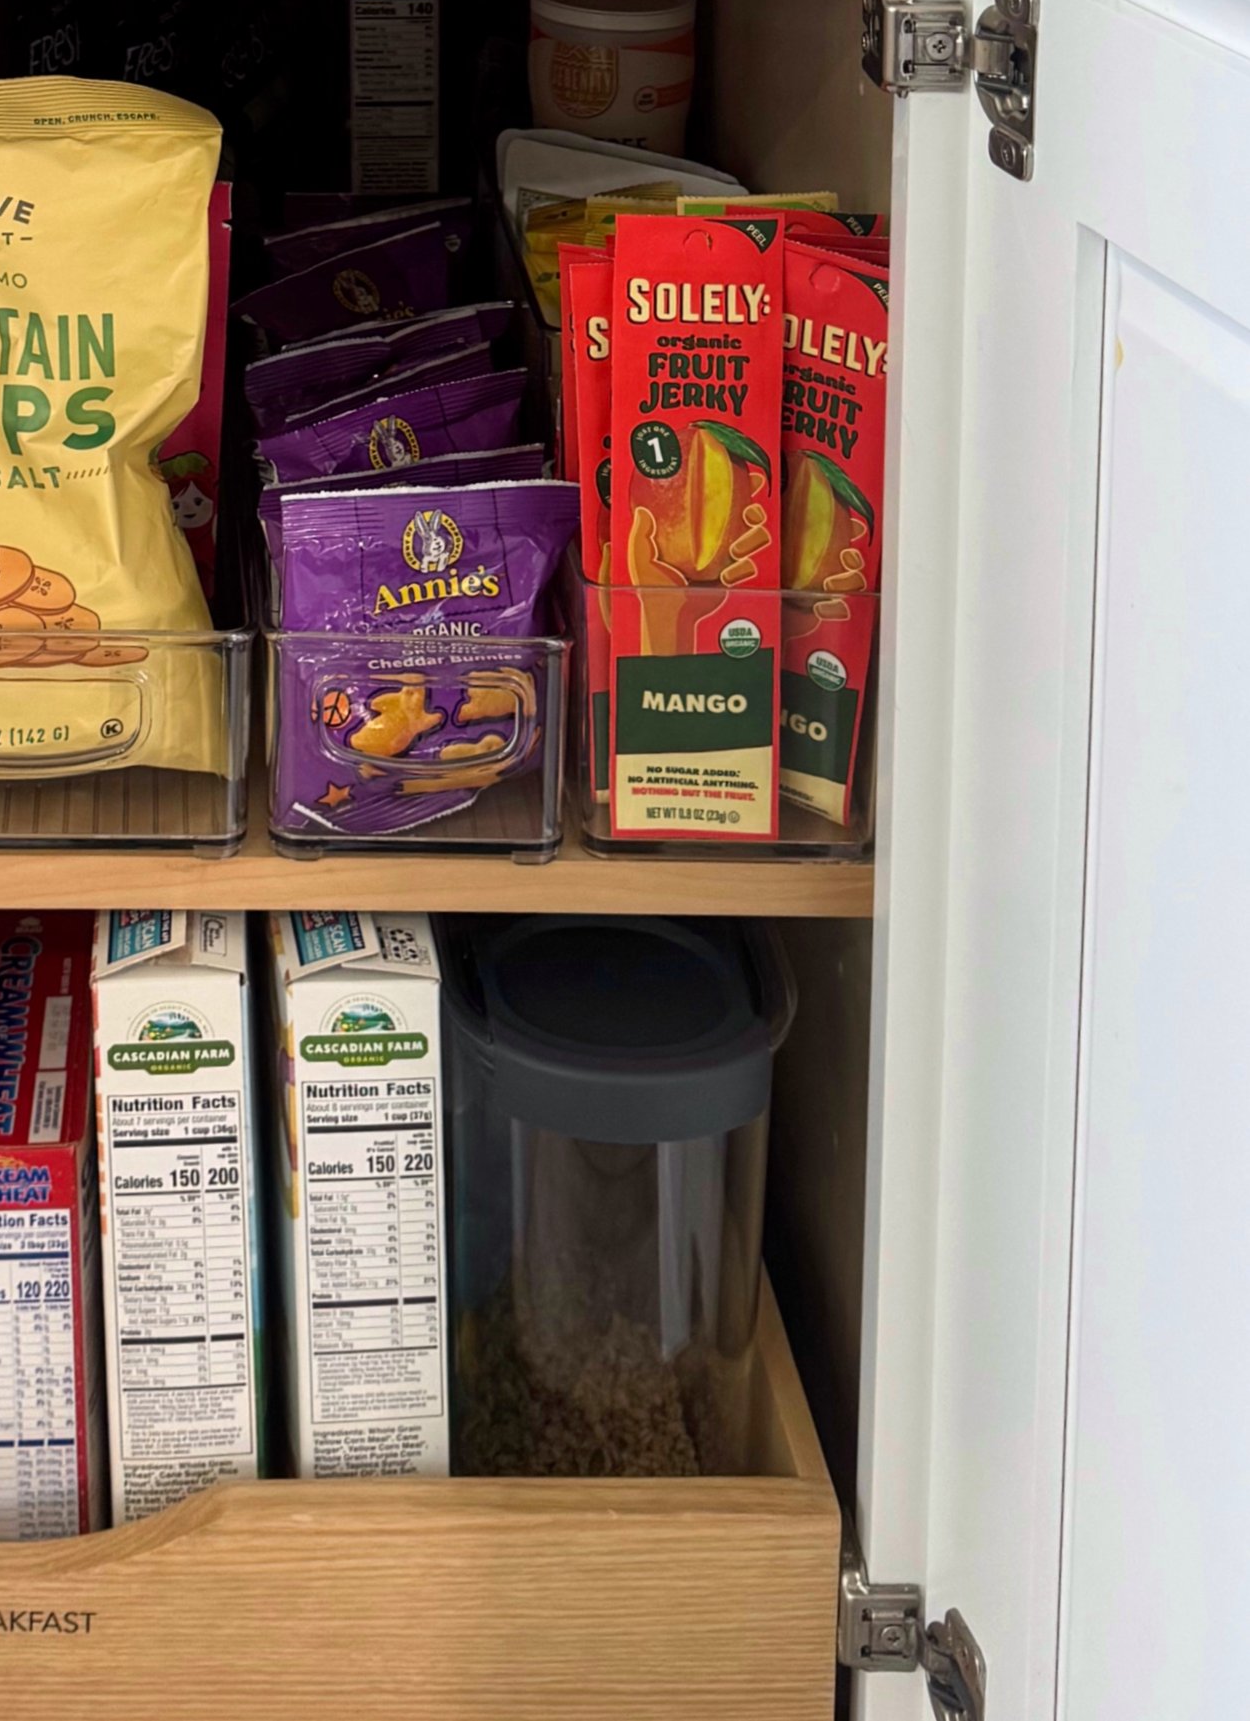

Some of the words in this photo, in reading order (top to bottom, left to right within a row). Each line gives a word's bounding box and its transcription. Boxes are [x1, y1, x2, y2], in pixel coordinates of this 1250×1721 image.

[656, 333, 742, 350] organic
[648, 353, 750, 382] FRUIT
[639, 381, 749, 417] JERKY
[373, 564, 500, 615] Annie's
[368, 657, 446, 671] Cheddar
[450, 651, 523, 664] Bunnies
[642, 690, 748, 714] MANGO
[113, 1050, 190, 1063] CASCADIAN
[194, 1047, 230, 1060] FARM
[305, 1041, 383, 1055] CASCADIAN
[387, 1040, 423, 1052] FARM
[306, 1084, 379, 1099] Nutrition
[386, 1081, 431, 1097] Facts
[112, 1097, 183, 1113] Nutrition
[192, 1095, 236, 1110] Facts
[308, 1162, 354, 1175] Calories
[366, 1155, 396, 1173] 150
[403, 1153, 434, 1171] 220
[114, 1175, 164, 1189] Calories
[169, 1169, 200, 1187] 150
[208, 1166, 239, 1185] 200
[29, 1213, 69, 1228] Facts
[16, 1280, 41, 1299] 120
[44, 1280, 70, 1298] 220
